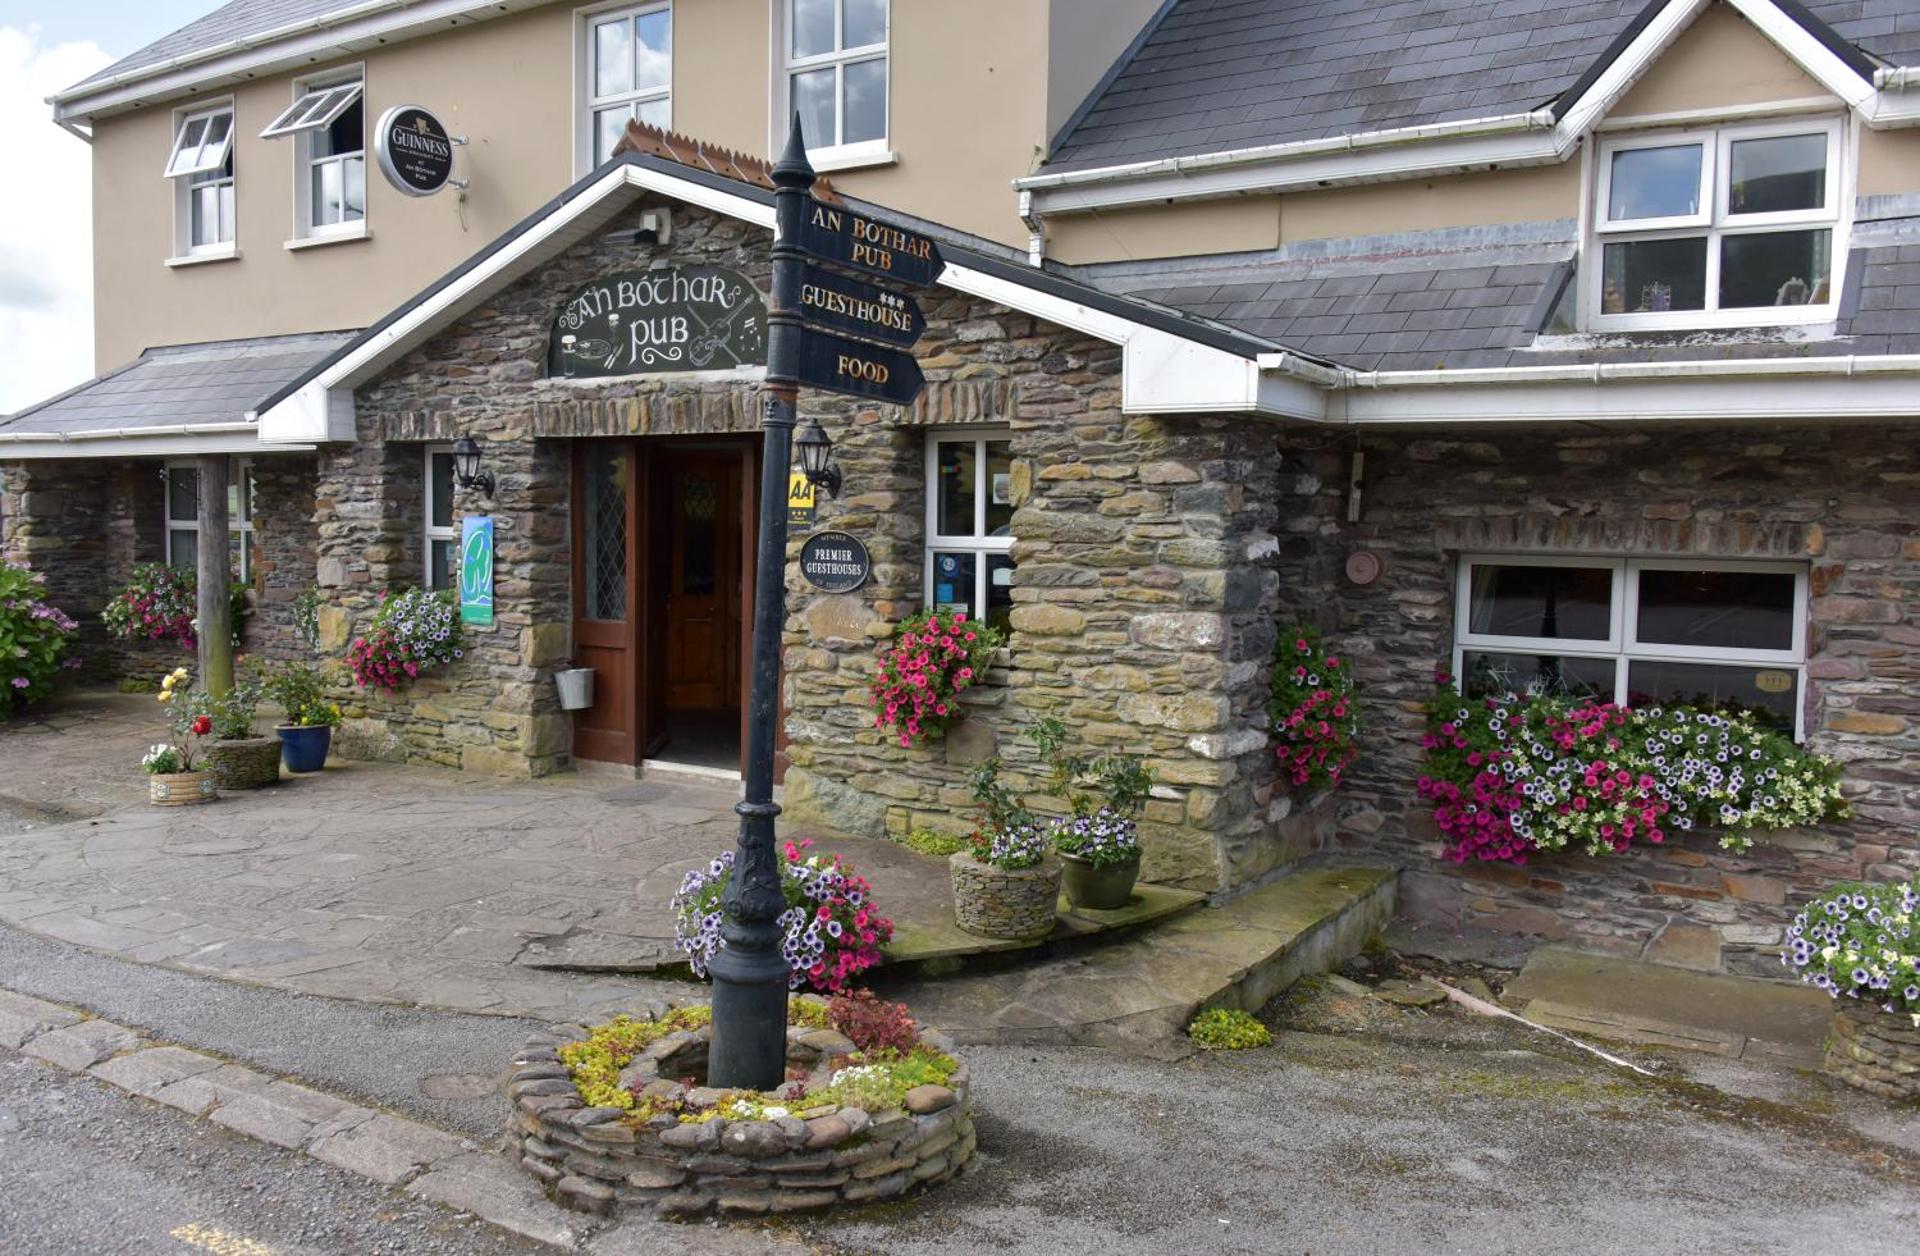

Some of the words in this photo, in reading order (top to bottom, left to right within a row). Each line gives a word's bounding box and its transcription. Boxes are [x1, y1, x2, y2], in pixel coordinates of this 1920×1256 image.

[392, 127, 449, 158] GUINNESS
[811, 207, 842, 232] AN
[851, 242, 891, 270] PUB
[802, 284, 912, 332] GUESTHOUSE
[627, 315, 689, 367] PUB
[838, 355, 889, 384] FOOD
[790, 480, 811, 500] AA
[815, 548, 852, 561] PREMIER
[806, 562, 862, 576] GUESTHOUSES
